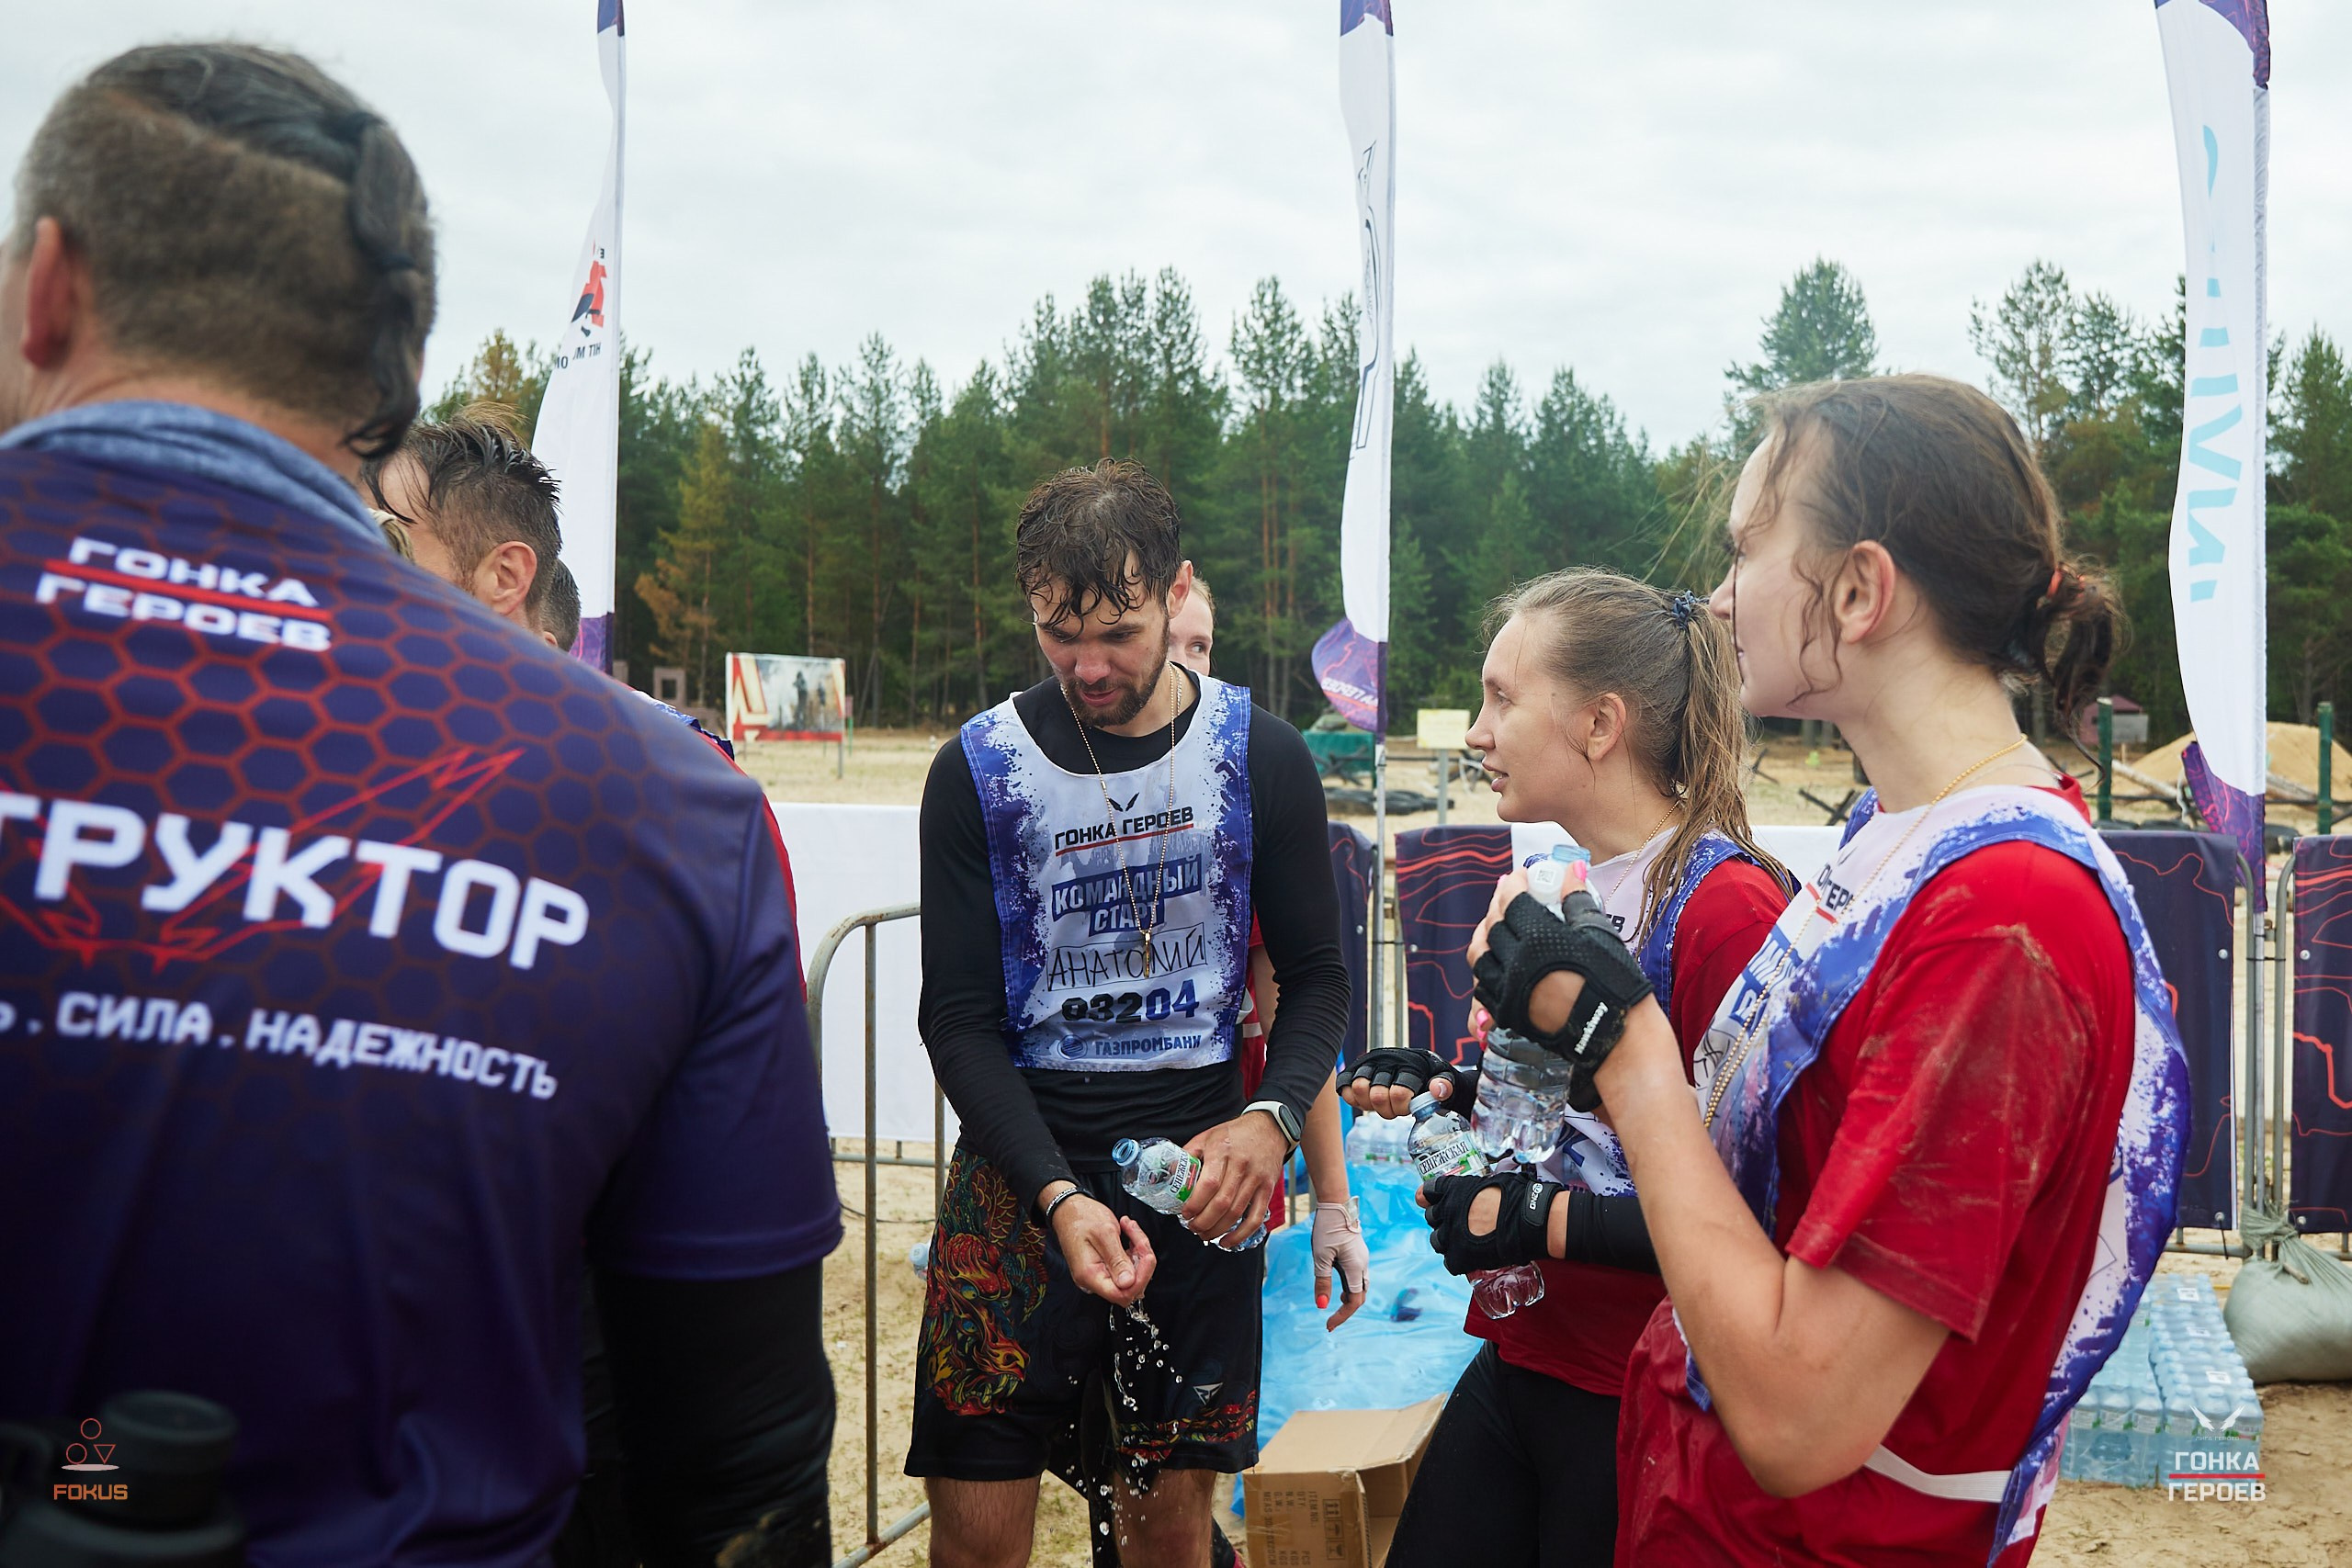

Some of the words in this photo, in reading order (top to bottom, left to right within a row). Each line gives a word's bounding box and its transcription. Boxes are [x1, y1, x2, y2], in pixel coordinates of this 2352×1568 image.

[69, 536, 318, 606] ГОНКА
[35, 574, 333, 652] ГЕРОЕВ
[1055, 823, 1116, 850] ГОНКА
[1122, 806, 1194, 835] ГЕРОЕВ
[1055, 854, 1200, 910] КОМАНДНЫЙ
[1093, 901, 1160, 931] СТАРТ
[1047, 928, 1204, 990] АНАТОЛИЙ
[56, 991, 213, 1046] СИЛА
[244, 1009, 558, 1100] НАДЕЖНОСТЬ
[1095, 1035, 1202, 1055] ГАЗПРОМБАНК
[1419, 1142, 1469, 1175] СЕНЕЖСКАЯ
